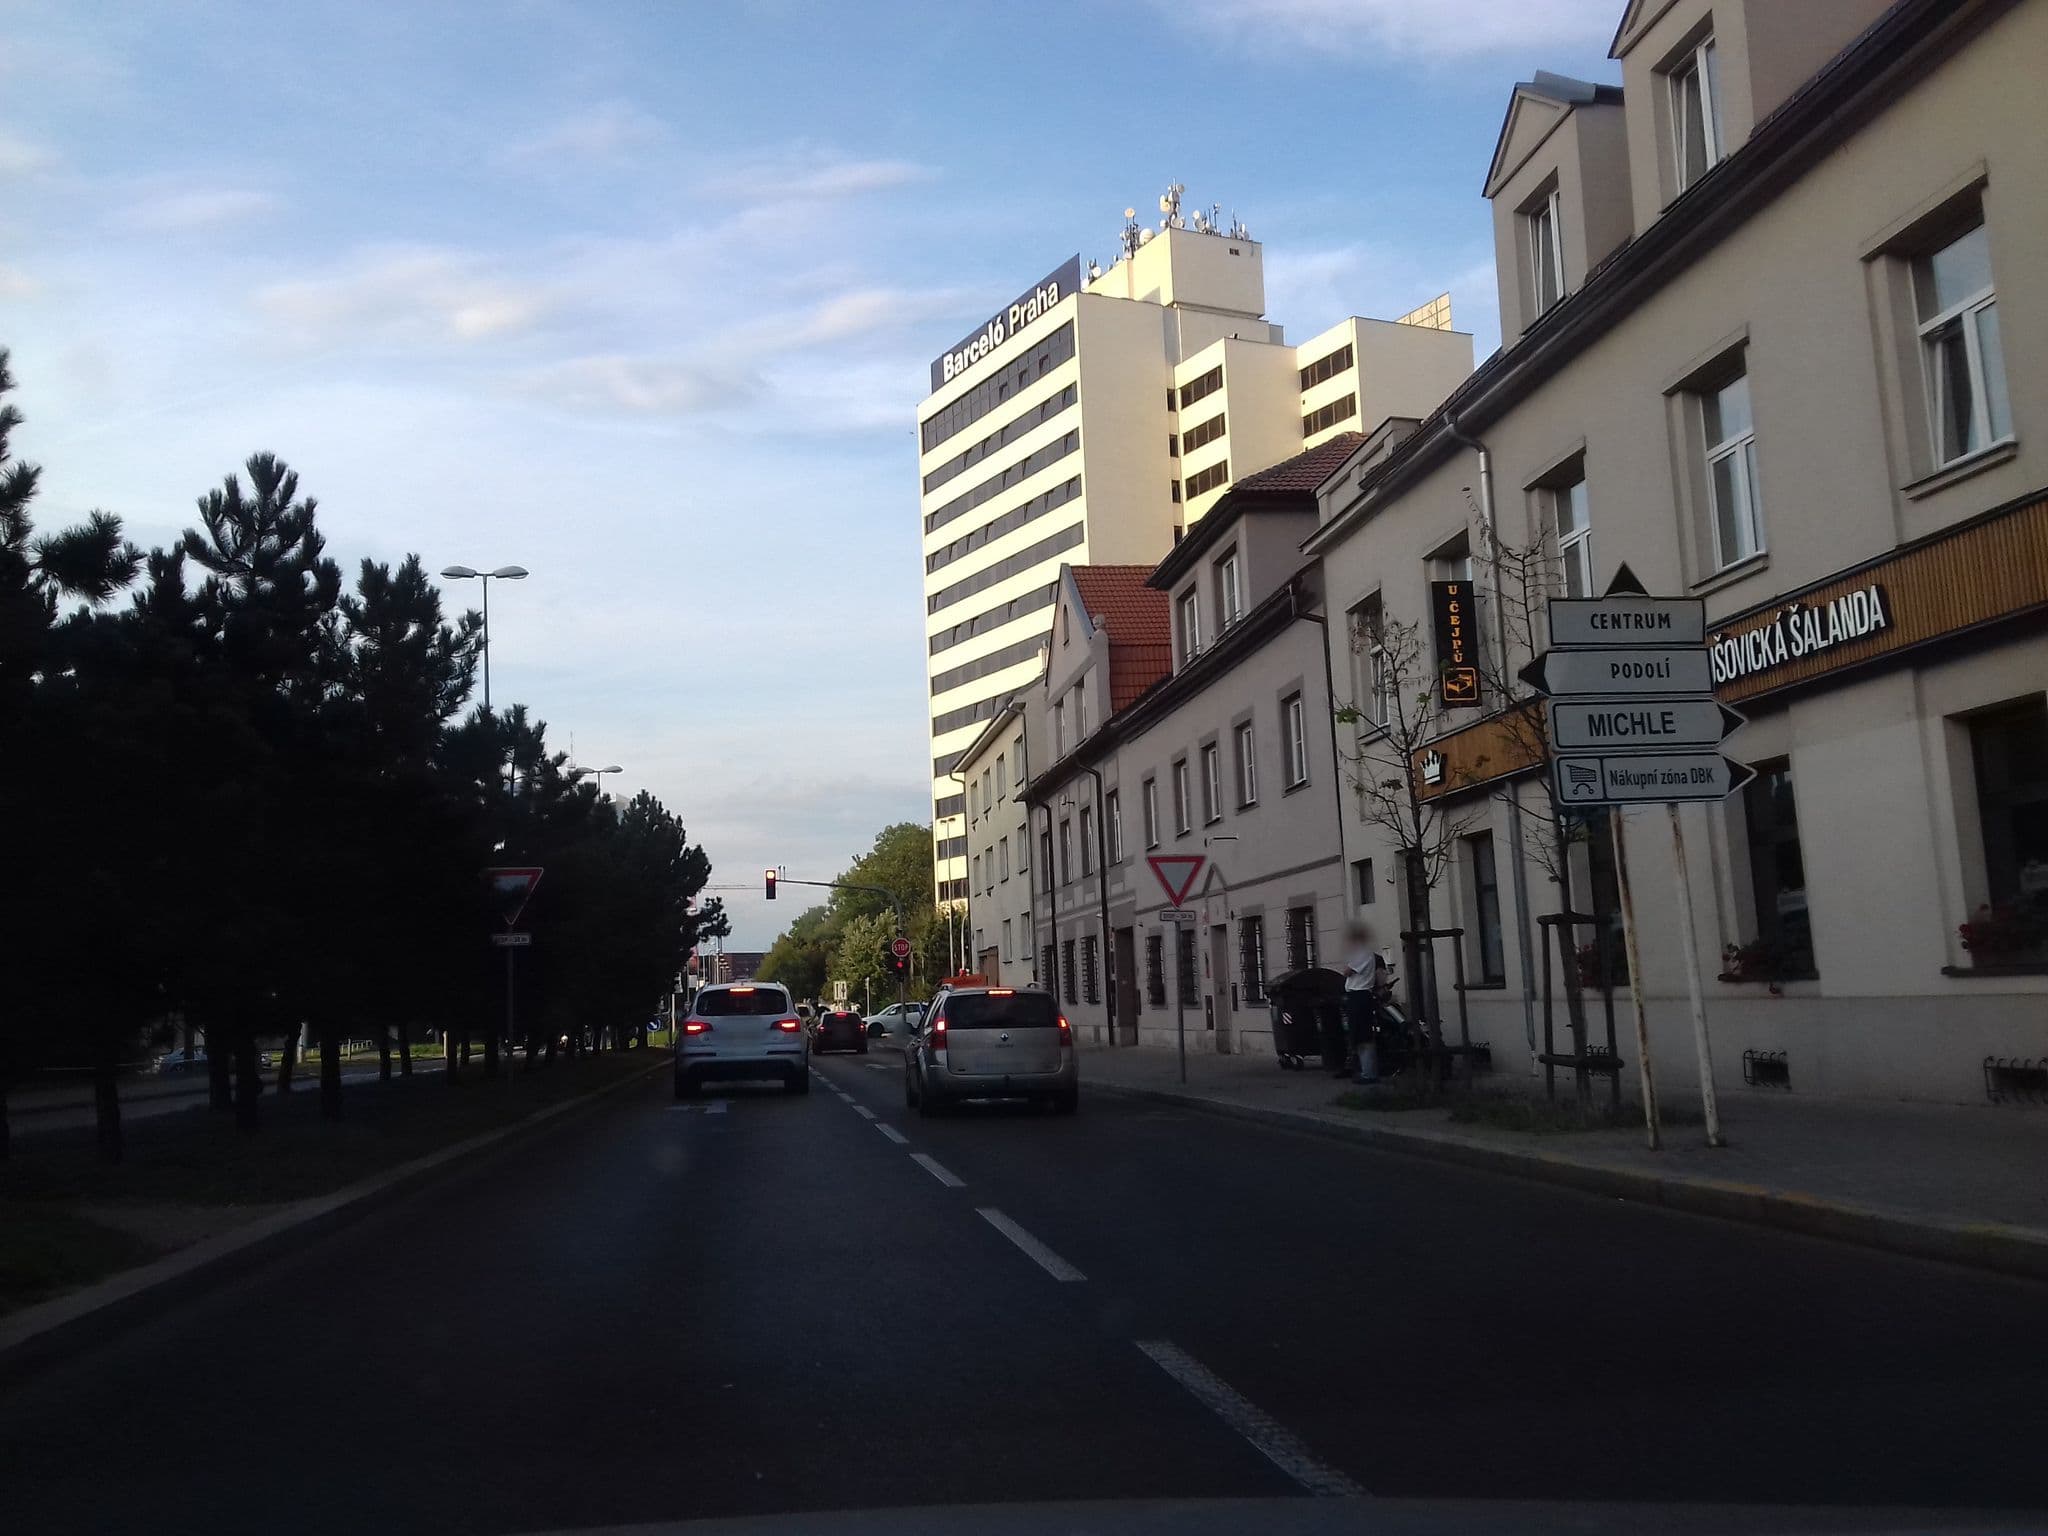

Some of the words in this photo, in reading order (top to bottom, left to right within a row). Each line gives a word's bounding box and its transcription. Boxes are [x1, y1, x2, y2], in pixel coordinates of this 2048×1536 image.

[943, 316, 1006, 383] Barceló
[1008, 282, 1059, 335] Praha
[1447, 585, 1458, 595] U
[1590, 613, 1671, 630] CENTRUM
[1789, 585, 1886, 657] ŠALANDA
[1610, 658, 1670, 679] PODOLÍ
[1588, 711, 1677, 737] MICHLE
[1609, 768, 1658, 789] Nákupní
[1660, 769, 1688, 785] zóna
[1691, 767, 1715, 784] DBK
[894, 943, 909, 952] STOP
